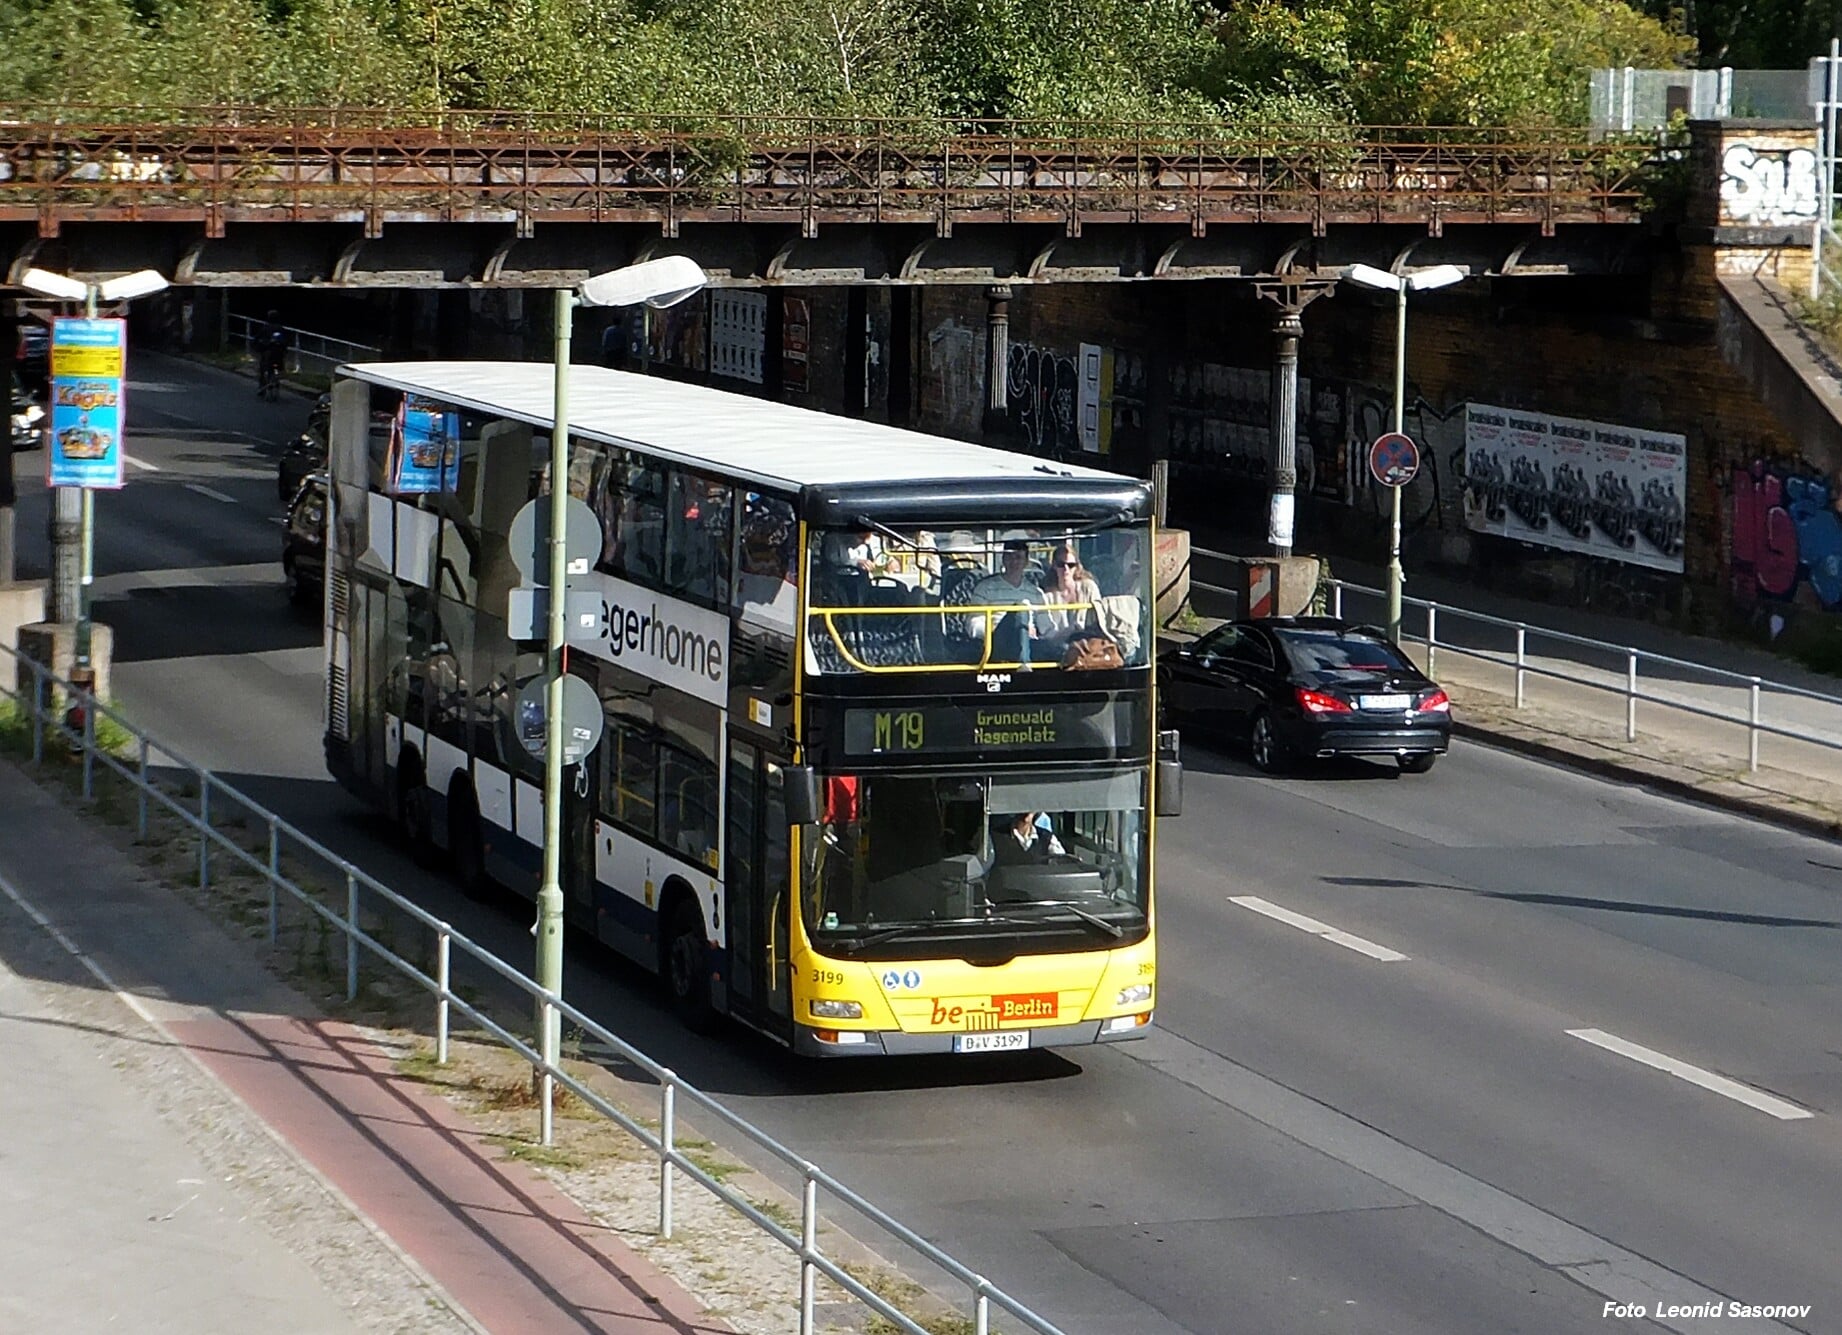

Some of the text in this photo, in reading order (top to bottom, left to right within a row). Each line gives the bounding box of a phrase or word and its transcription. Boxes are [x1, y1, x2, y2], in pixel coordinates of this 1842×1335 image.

[976, 673, 1012, 683] MAN
[976, 709, 1054, 726] Grunewald
[874, 712, 924, 750] M19
[973, 726, 1056, 745] Hagenplatz
[811, 969, 844, 985] 3199
[931, 997, 1053, 1025] be Berlin
[993, 1034, 1023, 1048] 3199
